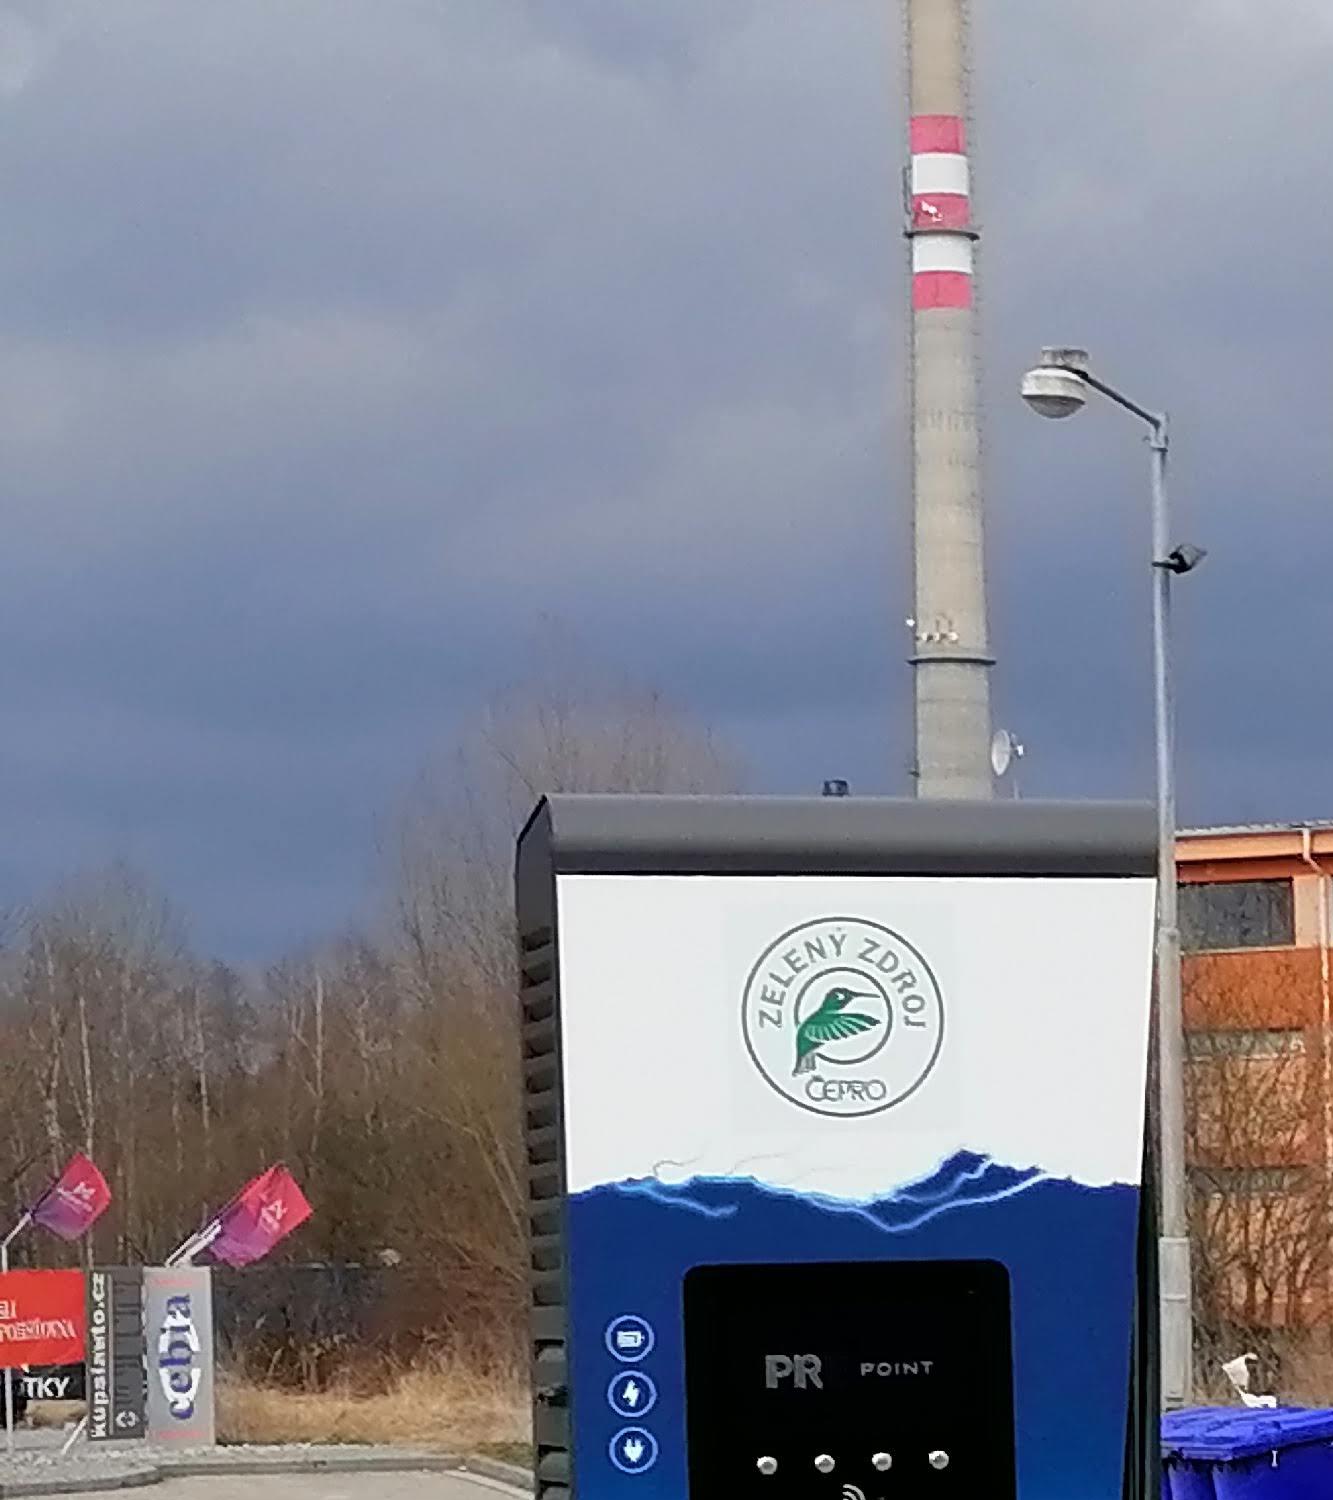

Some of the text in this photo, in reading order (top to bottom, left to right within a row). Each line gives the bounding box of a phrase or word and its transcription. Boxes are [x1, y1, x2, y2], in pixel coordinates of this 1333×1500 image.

[758, 926, 927, 1029] ZELENÝ ZDROJ
[160, 1293, 195, 1421] cebia
[859, 1360, 935, 1378] POINT
